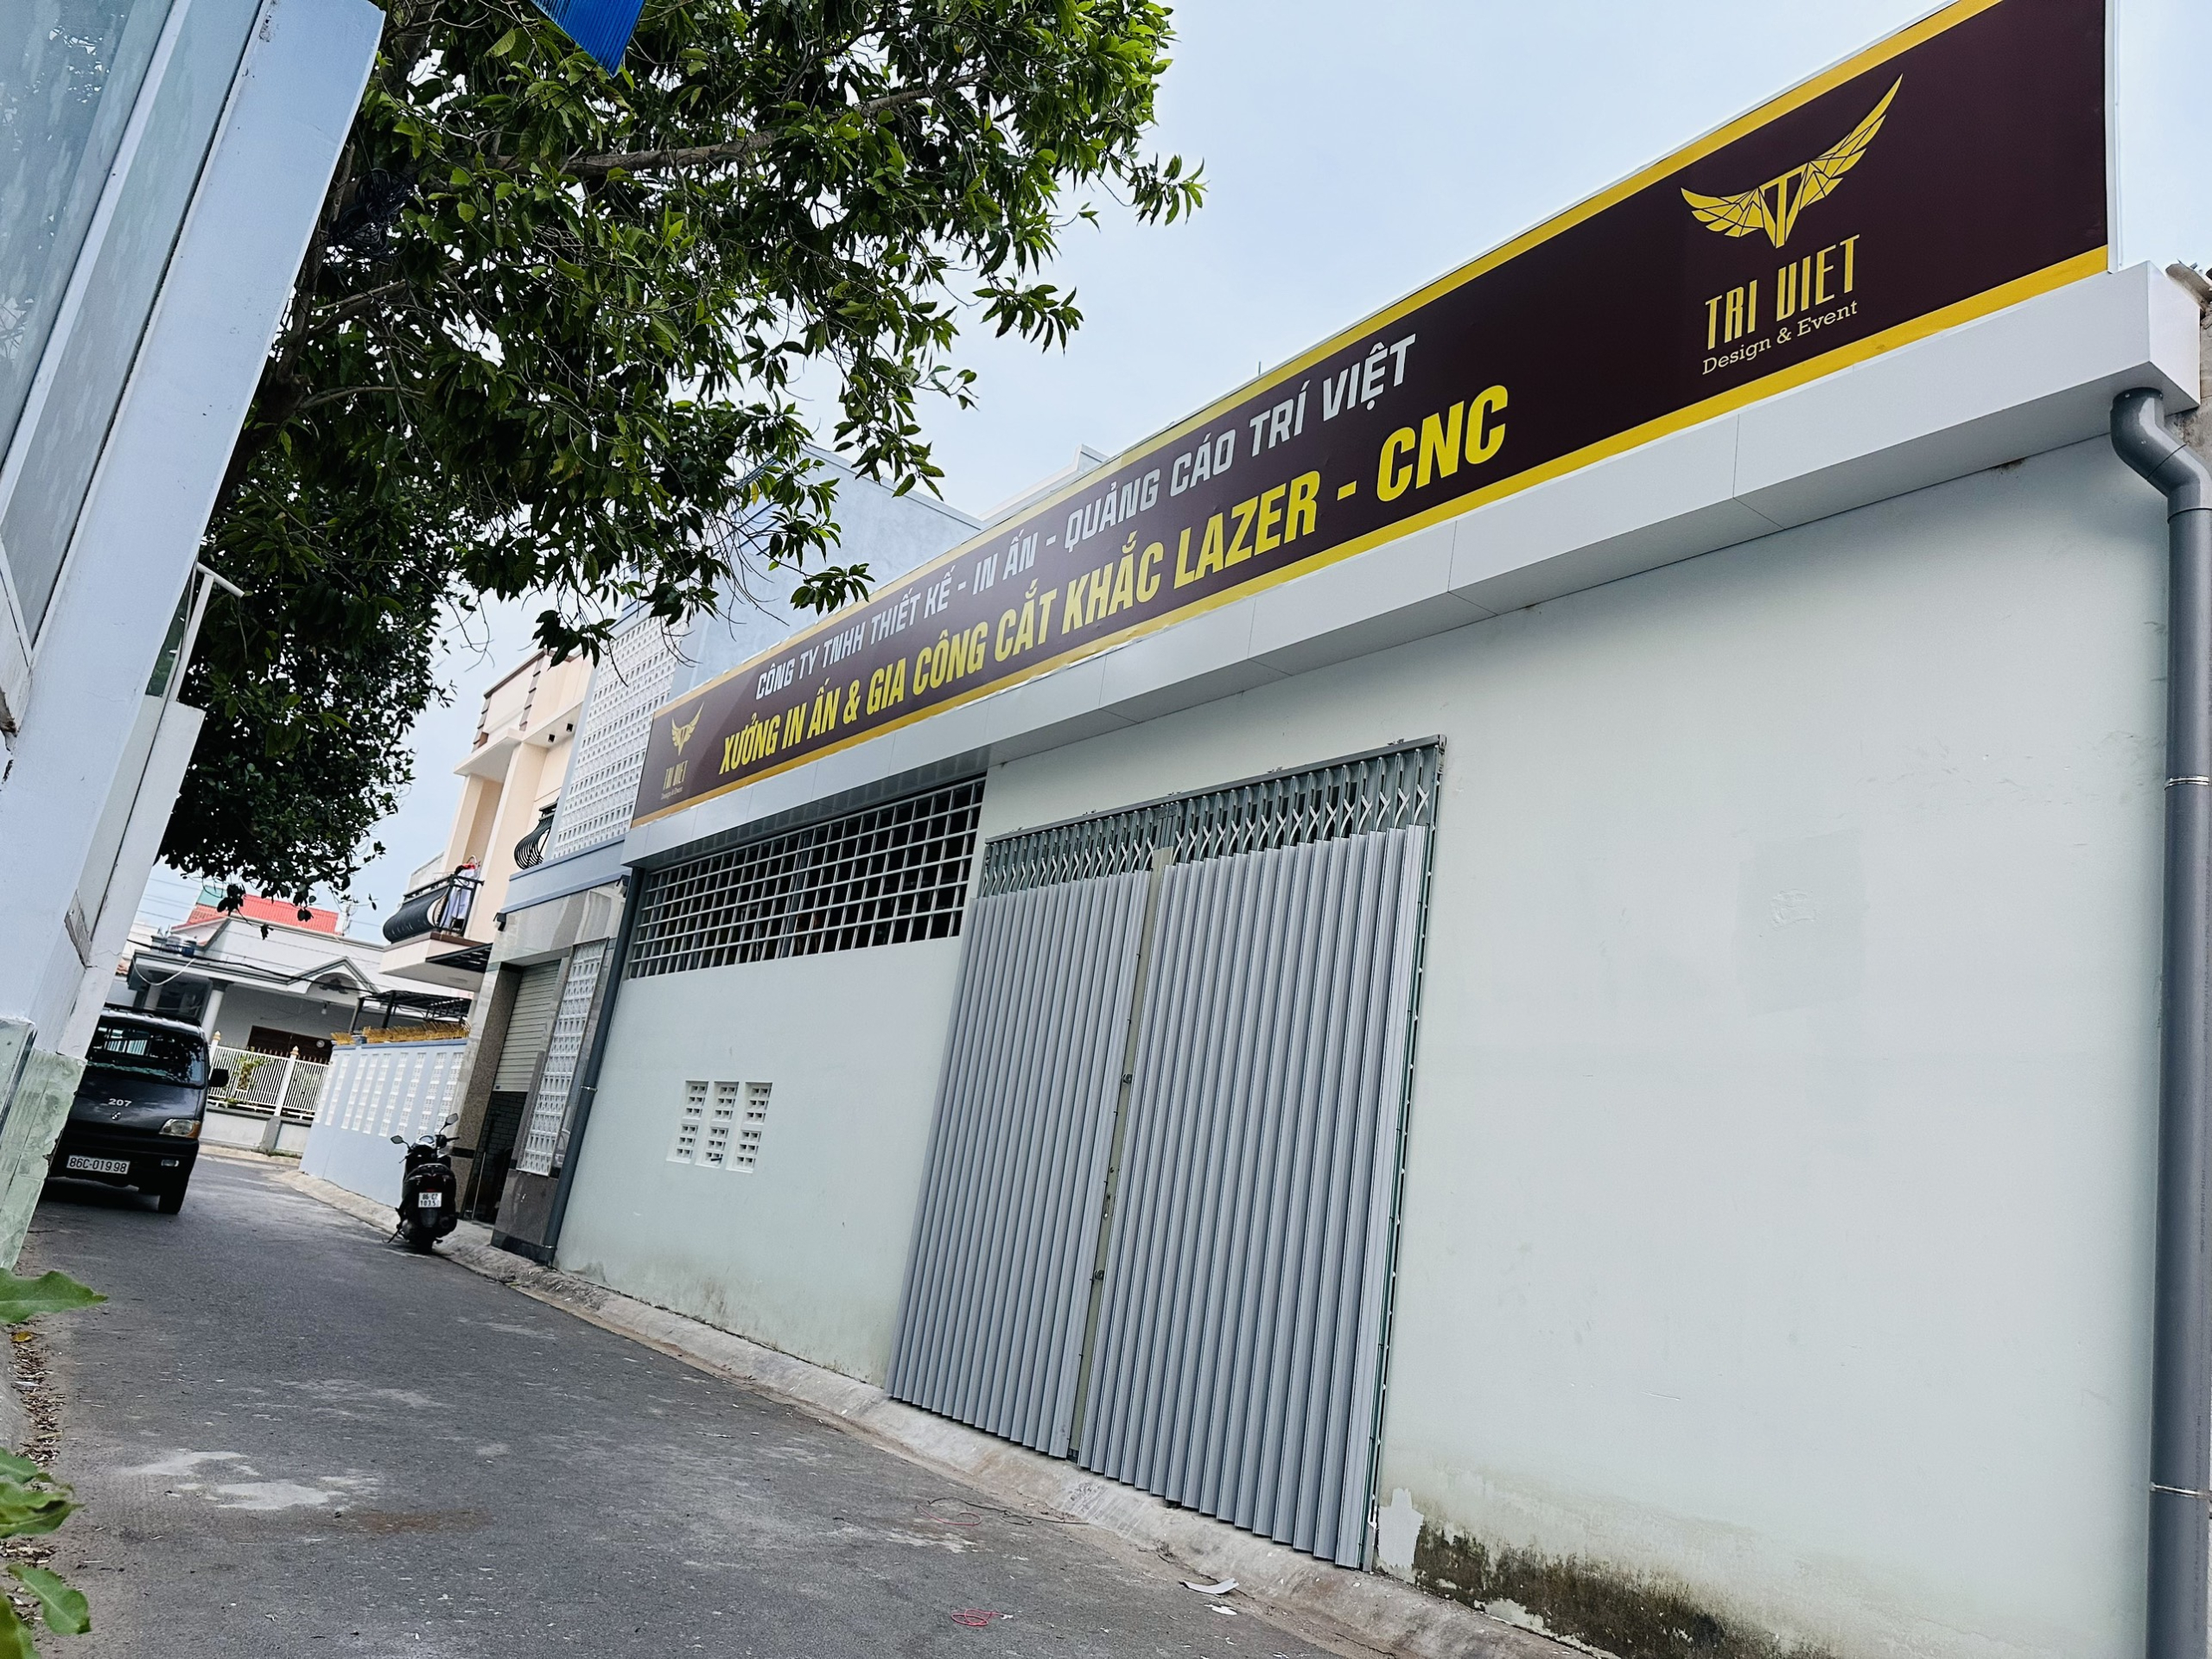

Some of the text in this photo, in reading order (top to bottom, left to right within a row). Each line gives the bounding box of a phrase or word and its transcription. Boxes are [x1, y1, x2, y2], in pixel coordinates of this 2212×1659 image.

[1702, 301, 1858, 375] Design & Event
[1705, 279, 1758, 351] TRI
[755, 334, 1416, 700] CÔNG TY TNHH THIẾT KẾ - IN ẤN - QUẢNG CÁO TRÍ VIỆT
[719, 385, 1508, 774] XƯỞNG IN ẤN & GIA CÔNG CẮT KHẮC LAZER - CNC
[108, 1098, 132, 1107] 207
